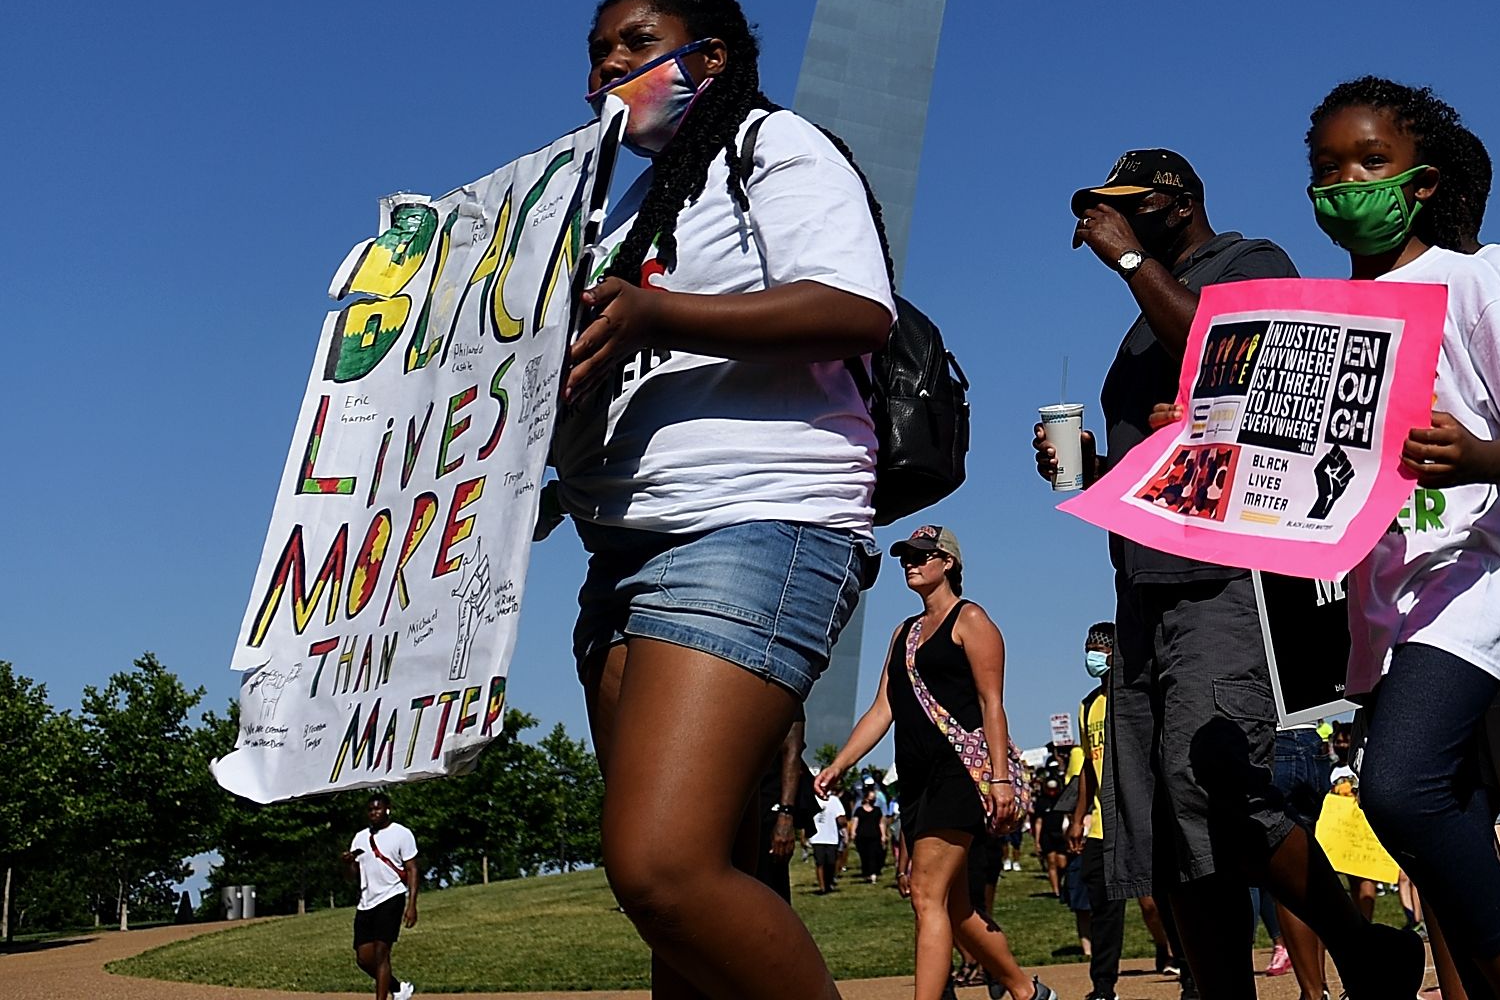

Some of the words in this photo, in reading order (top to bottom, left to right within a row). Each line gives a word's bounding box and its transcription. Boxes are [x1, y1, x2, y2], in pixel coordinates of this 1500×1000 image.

[322, 147, 594, 383] BLACK
[1266, 323, 1340, 353] INJUSTICE
[1344, 335, 1381, 369] EN
[1199, 363, 1249, 388] JSTCE
[1259, 346, 1335, 375] ANYWHERE
[1253, 368, 1267, 389] IS
[1265, 370, 1276, 391] A
[1277, 371, 1330, 398] THREAT
[1338, 372, 1377, 405] OU
[344, 393, 370, 408] Eric
[1248, 390, 1265, 413] TO
[1264, 391, 1325, 422] JUSTICE
[1241, 412, 1317, 441] EVERYWHERE.
[1330, 408, 1372, 443] GH
[1252, 454, 1289, 473] BLACK
[1248, 473, 1282, 491] LIVES
[1243, 491, 1289, 511] MATTER
[247, 475, 487, 648] MORE
[308, 631, 399, 698] THAN
[328, 675, 506, 783] MATTER
